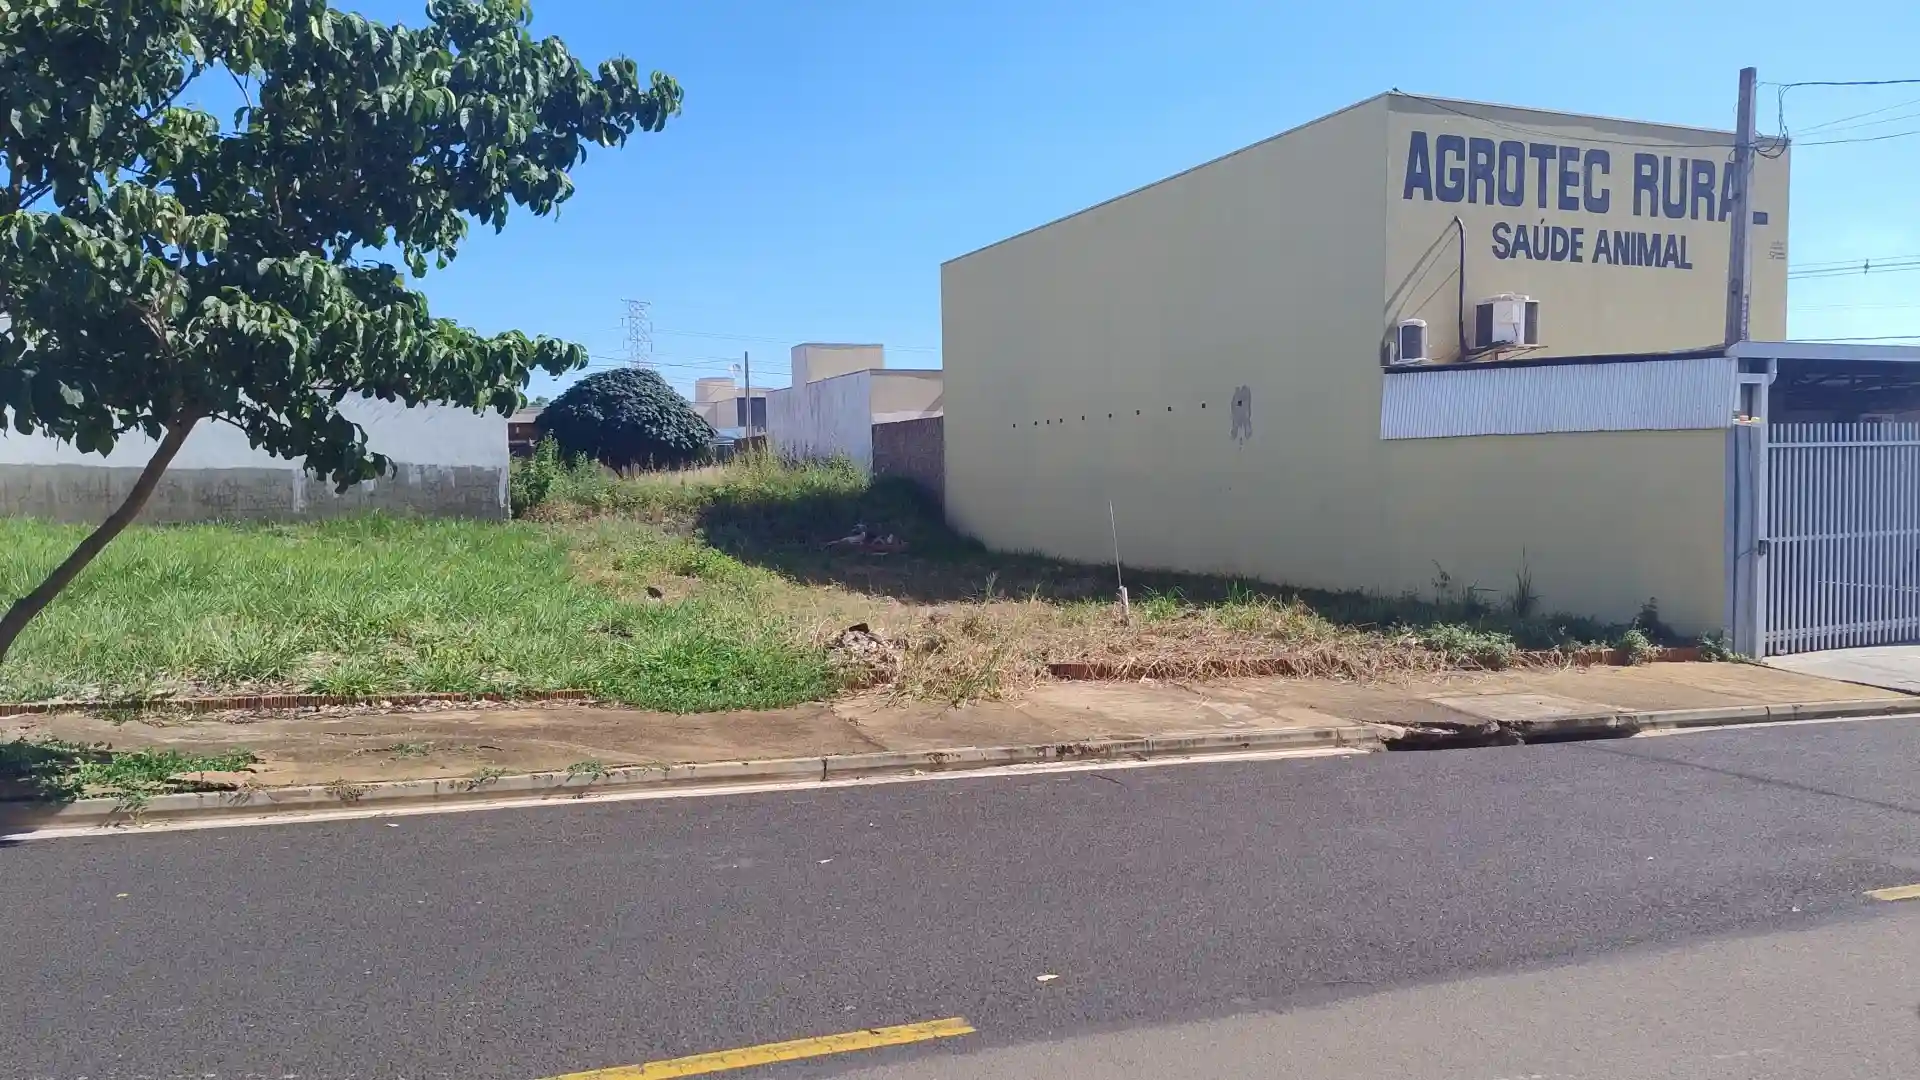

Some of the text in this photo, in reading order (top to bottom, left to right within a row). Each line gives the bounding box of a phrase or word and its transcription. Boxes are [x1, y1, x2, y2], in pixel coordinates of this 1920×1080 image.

[1403, 131, 1768, 225] AGROTEC RURA
[1492, 218, 1692, 269] SAÚDE ANIMAL
